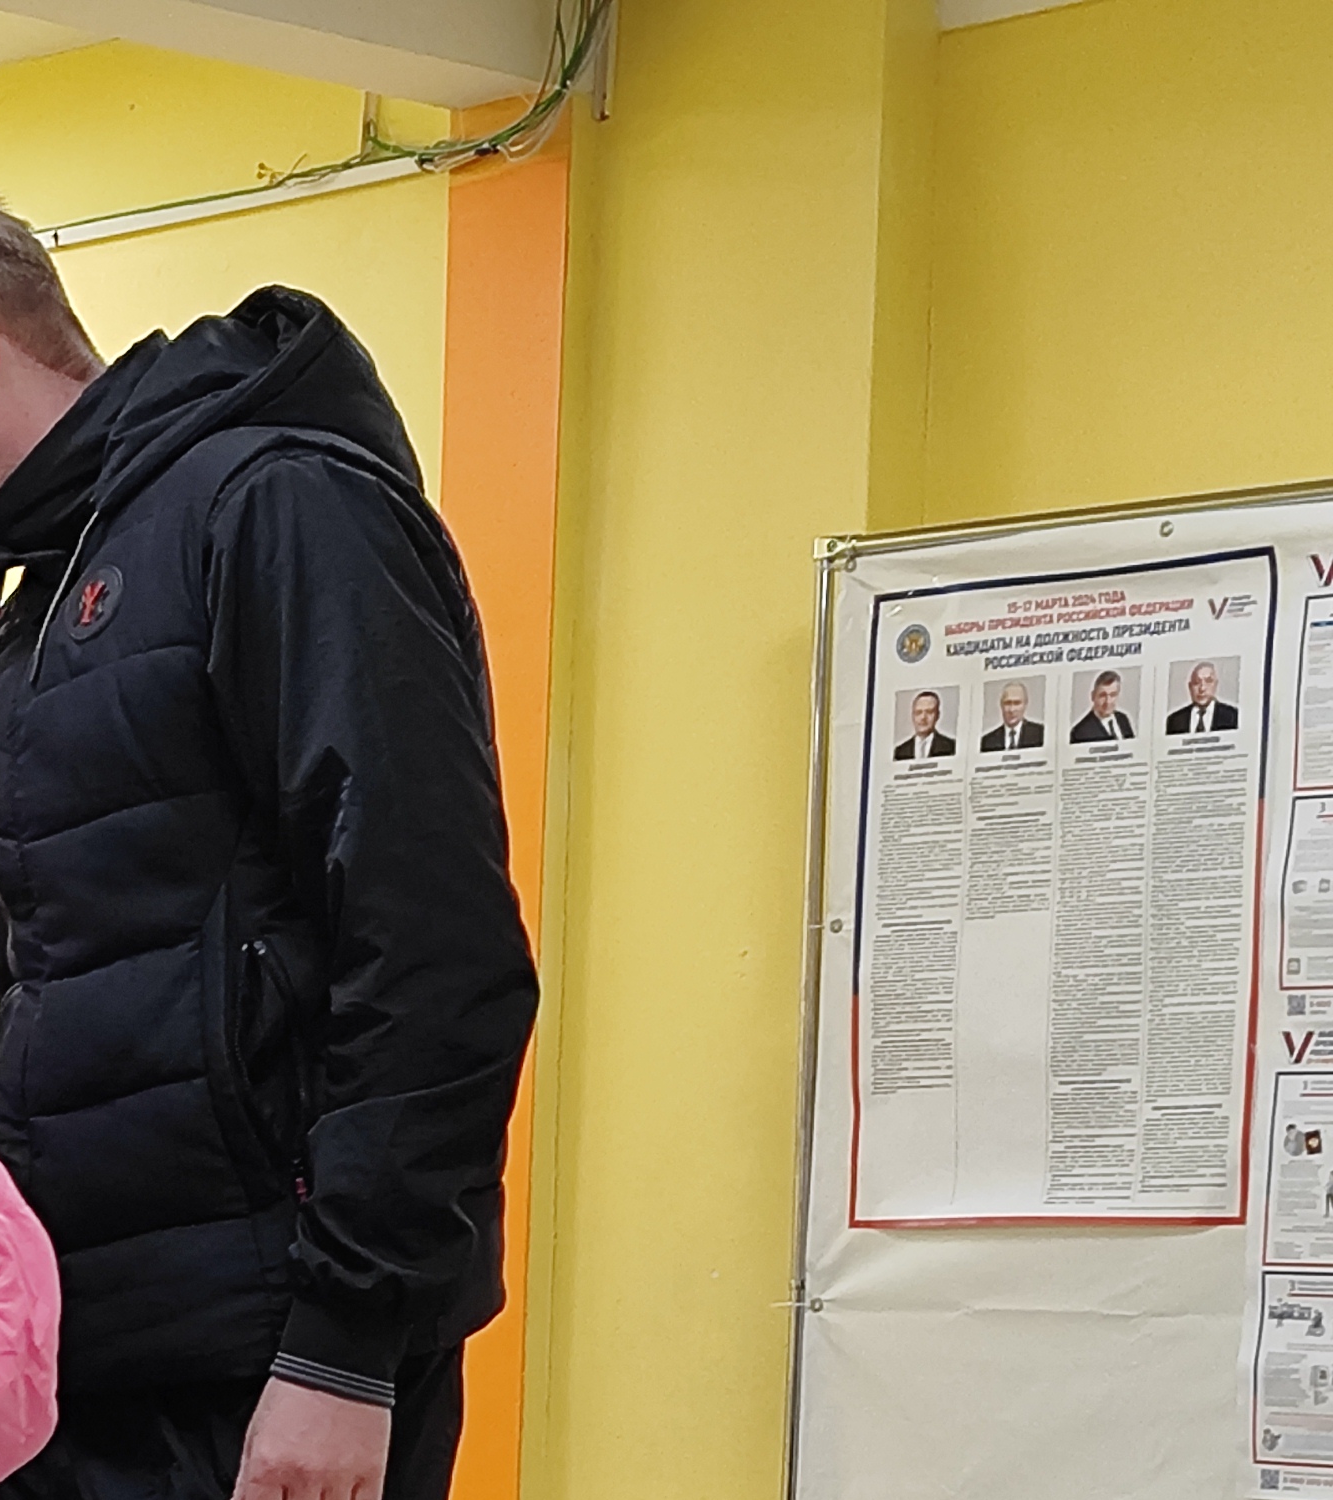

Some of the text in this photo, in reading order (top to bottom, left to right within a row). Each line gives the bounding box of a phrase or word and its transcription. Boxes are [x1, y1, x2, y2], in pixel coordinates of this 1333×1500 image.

[944, 597, 1193, 636] ВЫБОРЫ ПРЕЗИДЕНТА РОССИЙСКОЙ ФЕДЕРАЦИИ
[1034, 595, 1069, 610] МАРТА
[1071, 593, 1096, 607] 2024
[1098, 590, 1125, 605] ГОДА
[946, 617, 1190, 656] КАНДИДАТЫ НА ДОЛЖНОСТЬ ПРЕЗИДЕНТА
[984, 641, 1142, 671] РОССИЙСКОЙ ФЕДЕРАЦИИ
